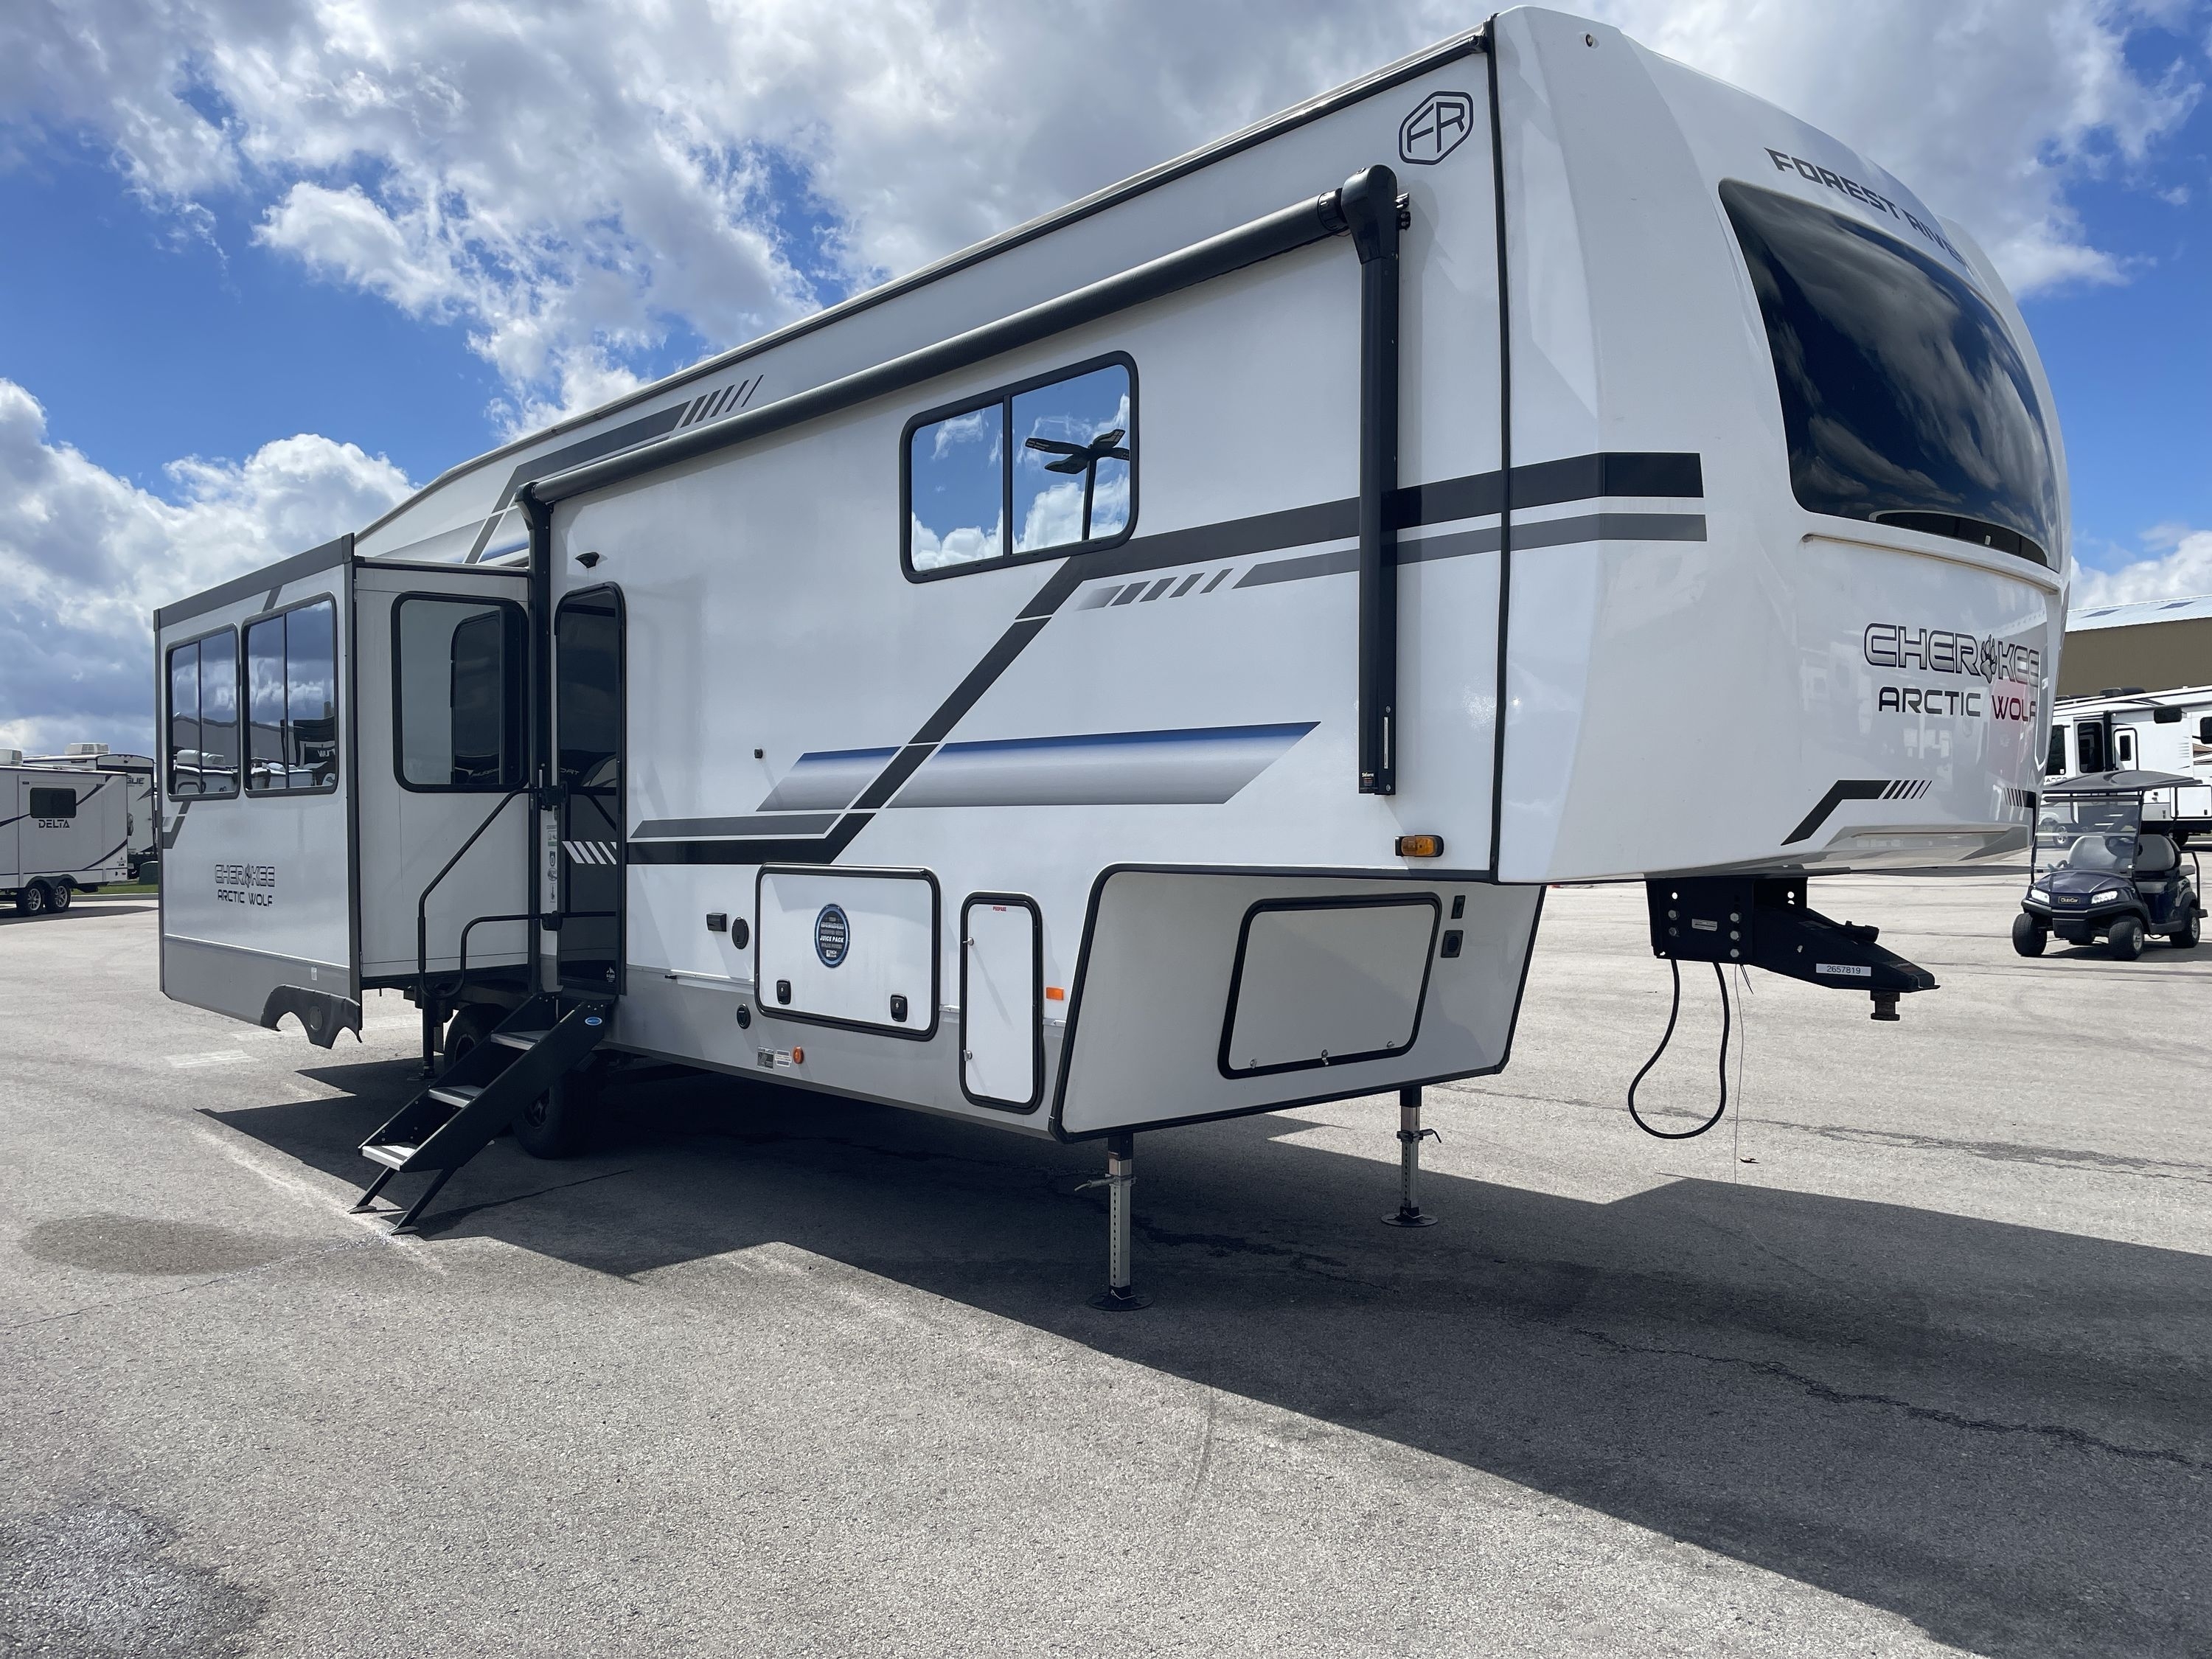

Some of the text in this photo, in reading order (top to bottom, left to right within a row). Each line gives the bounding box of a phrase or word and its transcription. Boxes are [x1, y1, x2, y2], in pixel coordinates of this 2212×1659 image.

[1764, 147, 1900, 220] FOREST
[1879, 686, 2037, 722] ARCTIC WOLF
[38, 819, 70, 828] DELTA
[218, 889, 273, 906] ARCTIC WOLF
[1826, 965, 1861, 974] 2657819
